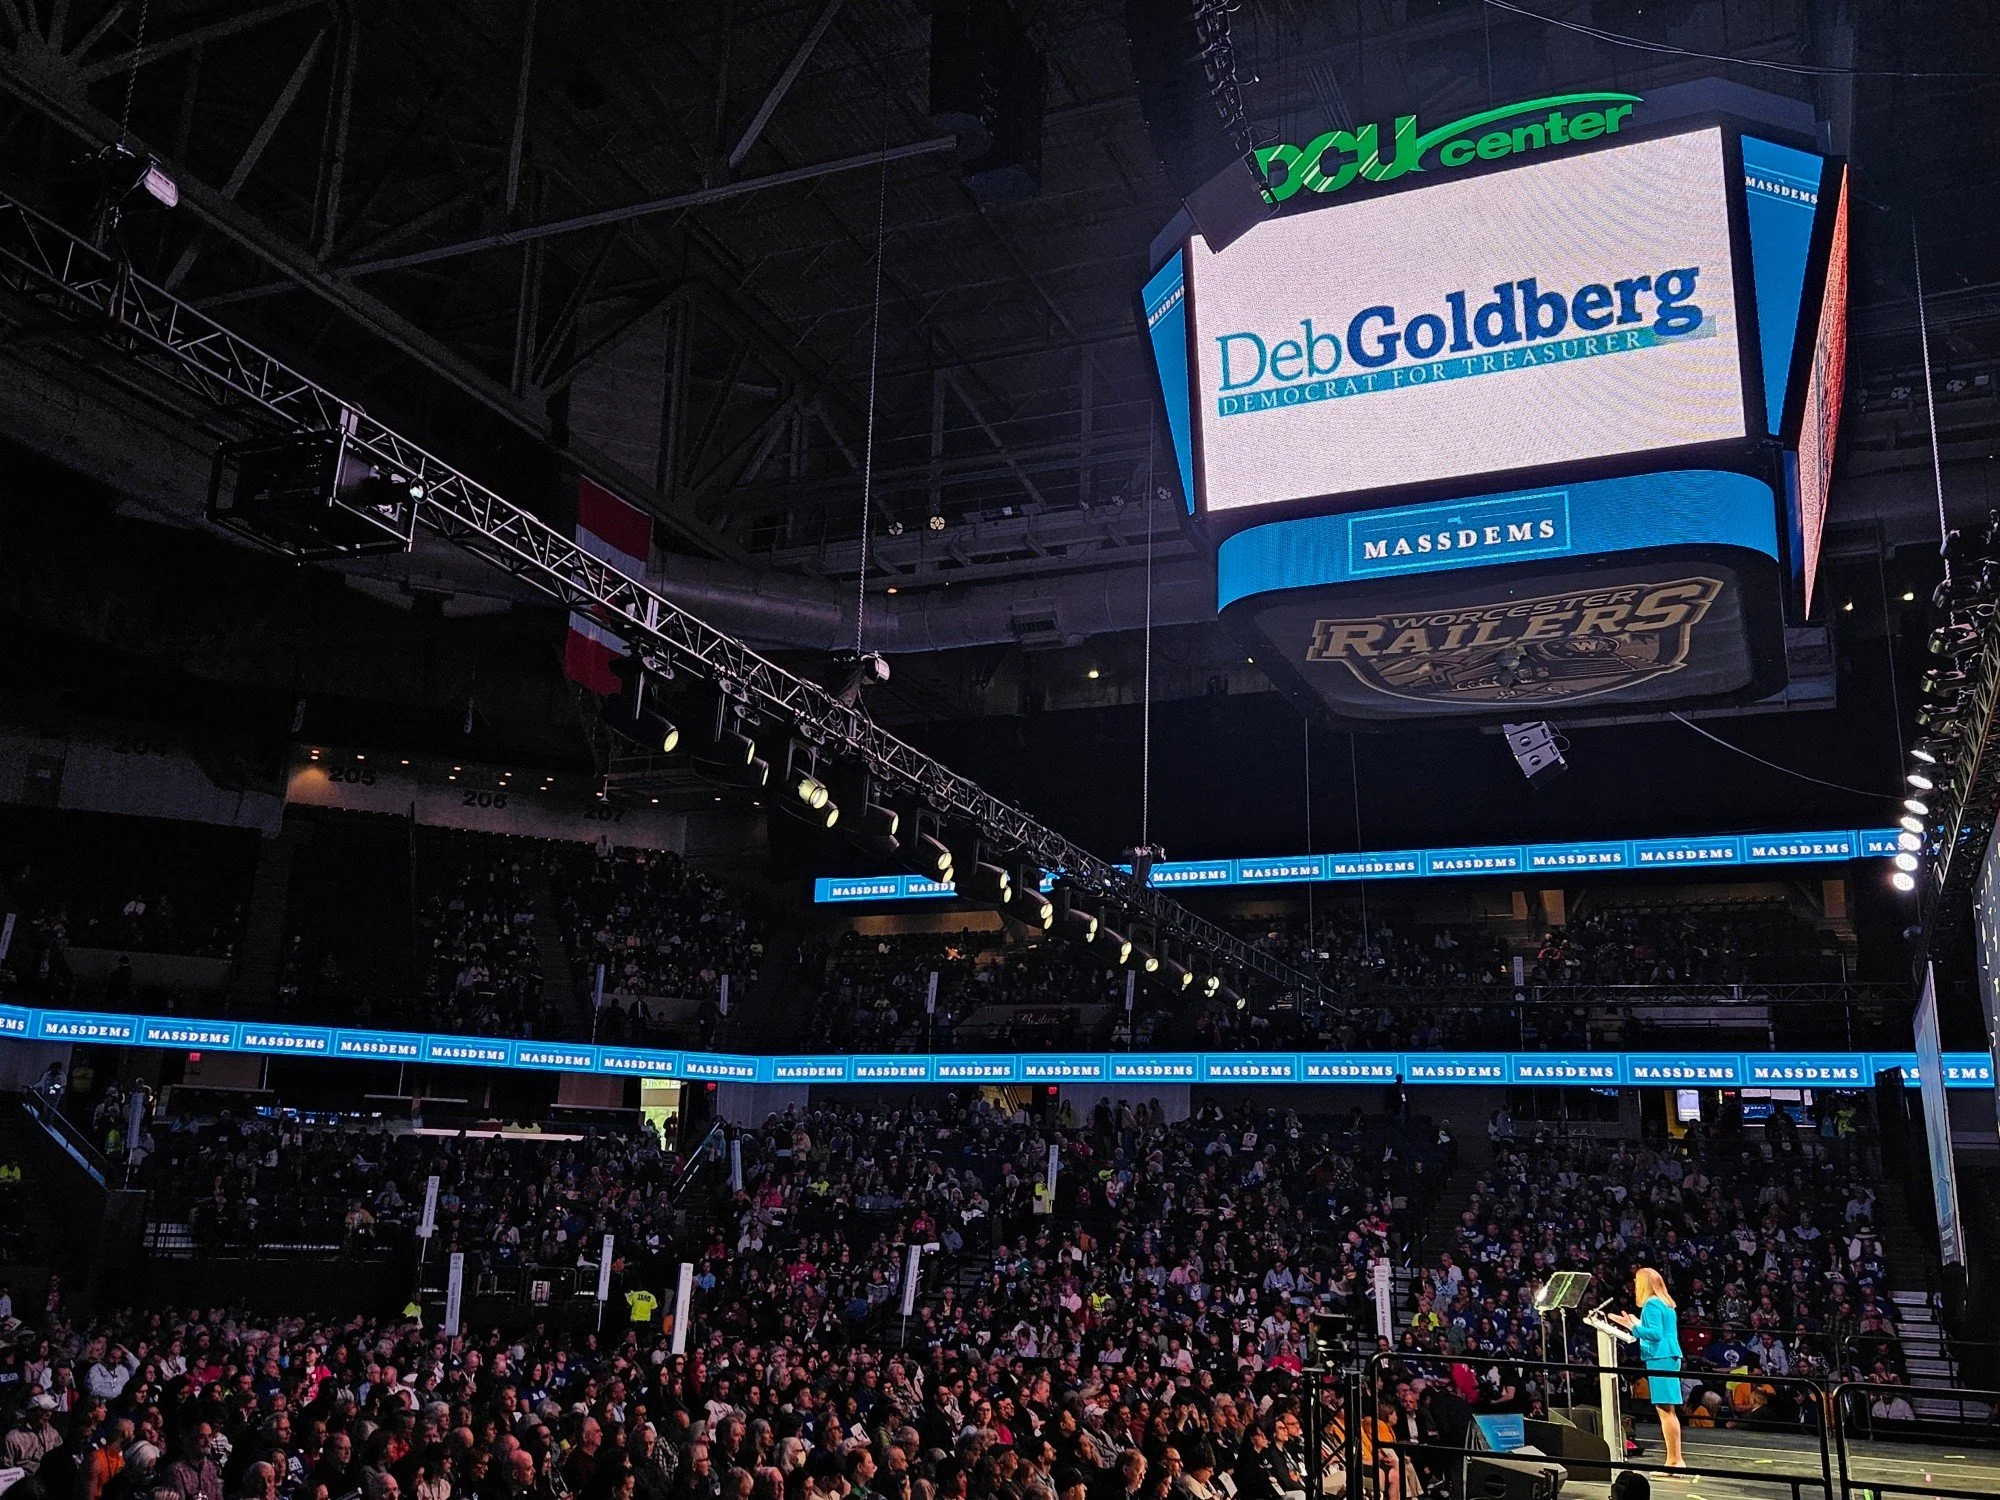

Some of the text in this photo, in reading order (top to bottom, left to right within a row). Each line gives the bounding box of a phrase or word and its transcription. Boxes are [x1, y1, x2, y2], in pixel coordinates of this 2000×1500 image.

[1254, 103, 1633, 204] DCU center
[1744, 176, 1818, 204] MASSDEMS
[1147, 285, 1185, 328] MASSDEMS
[1222, 330, 1641, 416] DEMOCRAT FOR TREASURER
[1363, 518, 1556, 560] MASSDEMS
[1392, 588, 1640, 628] WORCESTER
[1321, 583, 1703, 658] RAILERS
[462, 789, 507, 809] 206
[1640, 848, 1733, 861] MASSDEMS
[1752, 843, 1849, 857] MASSDEMS
[1432, 857, 1516, 870] MASSDEMS
[1533, 853, 1622, 866] MASSDEMS
[1242, 866, 1320, 878] MASSDEMS
[1334, 861, 1415, 874] MASSDEMS
[1153, 870, 1227, 882] MASSDEMS
[833, 884, 896, 896] MASSDEMS
[45, 1023, 130, 1037] MASSDEMS
[148, 1029, 230, 1044] MASSDEMS
[245, 1035, 325, 1049] MASSDEMS
[340, 1041, 417, 1055] MASSDEMS
[431, 1046, 505, 1060] MASSDEMS
[520, 1053, 591, 1066] MASSDEMS
[604, 1058, 673, 1071] MASSDEMS
[686, 1063, 754, 1076] MASSDEMS
[939, 1066, 1011, 1076] MASSDEMS
[1026, 1066, 1101, 1076] MASSDEMS
[1115, 1065, 1193, 1076] MASSDEMS
[1210, 1066, 1291, 1076] MASSDEMS
[1307, 1066, 1393, 1076] MASSDEMS
[777, 1067, 843, 1077] MASSDEMS
[857, 1067, 926, 1077] MASSDEMS
[1412, 1066, 1501, 1077] MASSDEMS
[1519, 1066, 1614, 1078] MASSDEMS
[1634, 1067, 1734, 1079] MASSDEMS
[1754, 1067, 1859, 1079] MASSDEMS
